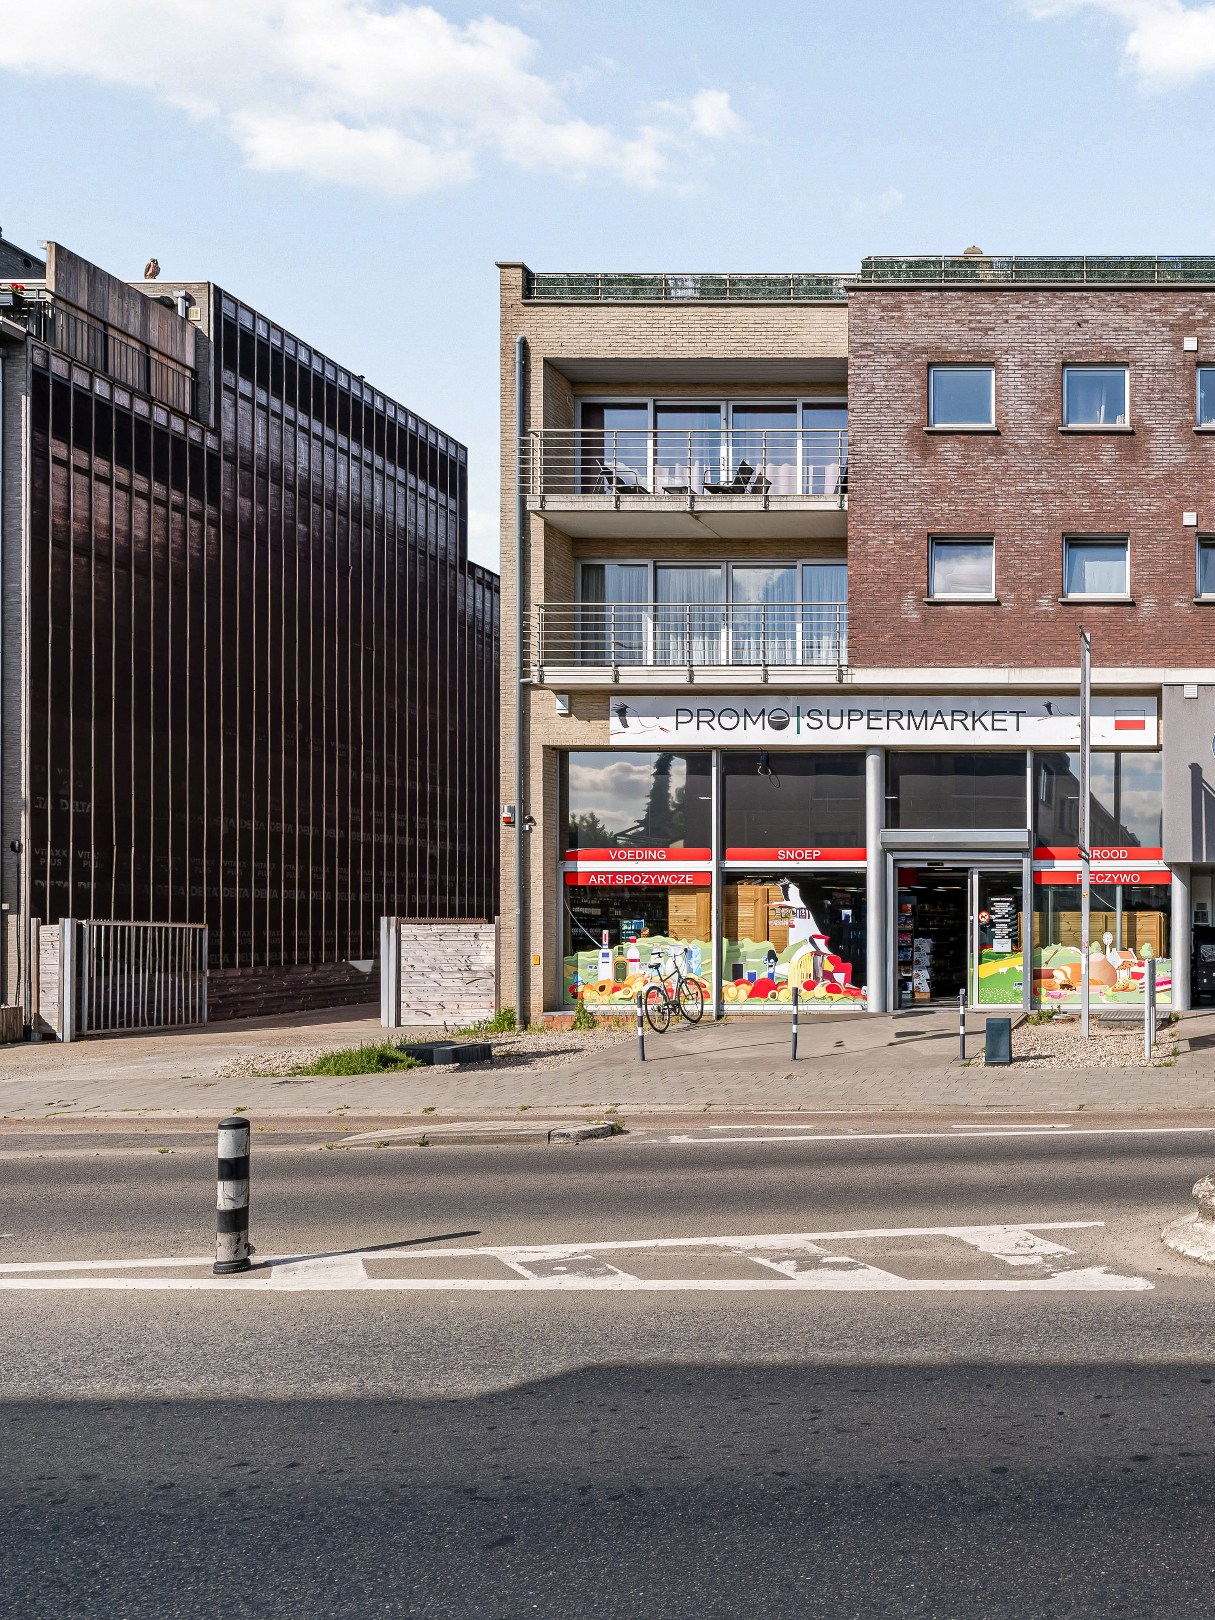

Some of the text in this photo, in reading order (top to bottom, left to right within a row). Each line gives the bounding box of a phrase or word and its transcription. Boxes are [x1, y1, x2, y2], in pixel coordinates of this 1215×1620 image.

[675, 707, 1027, 732] PROMO SUPERMARKET
[609, 850, 667, 860] VOEDING
[777, 849, 821, 860] SNOEP
[1076, 873, 1140, 883] PECZYWO
